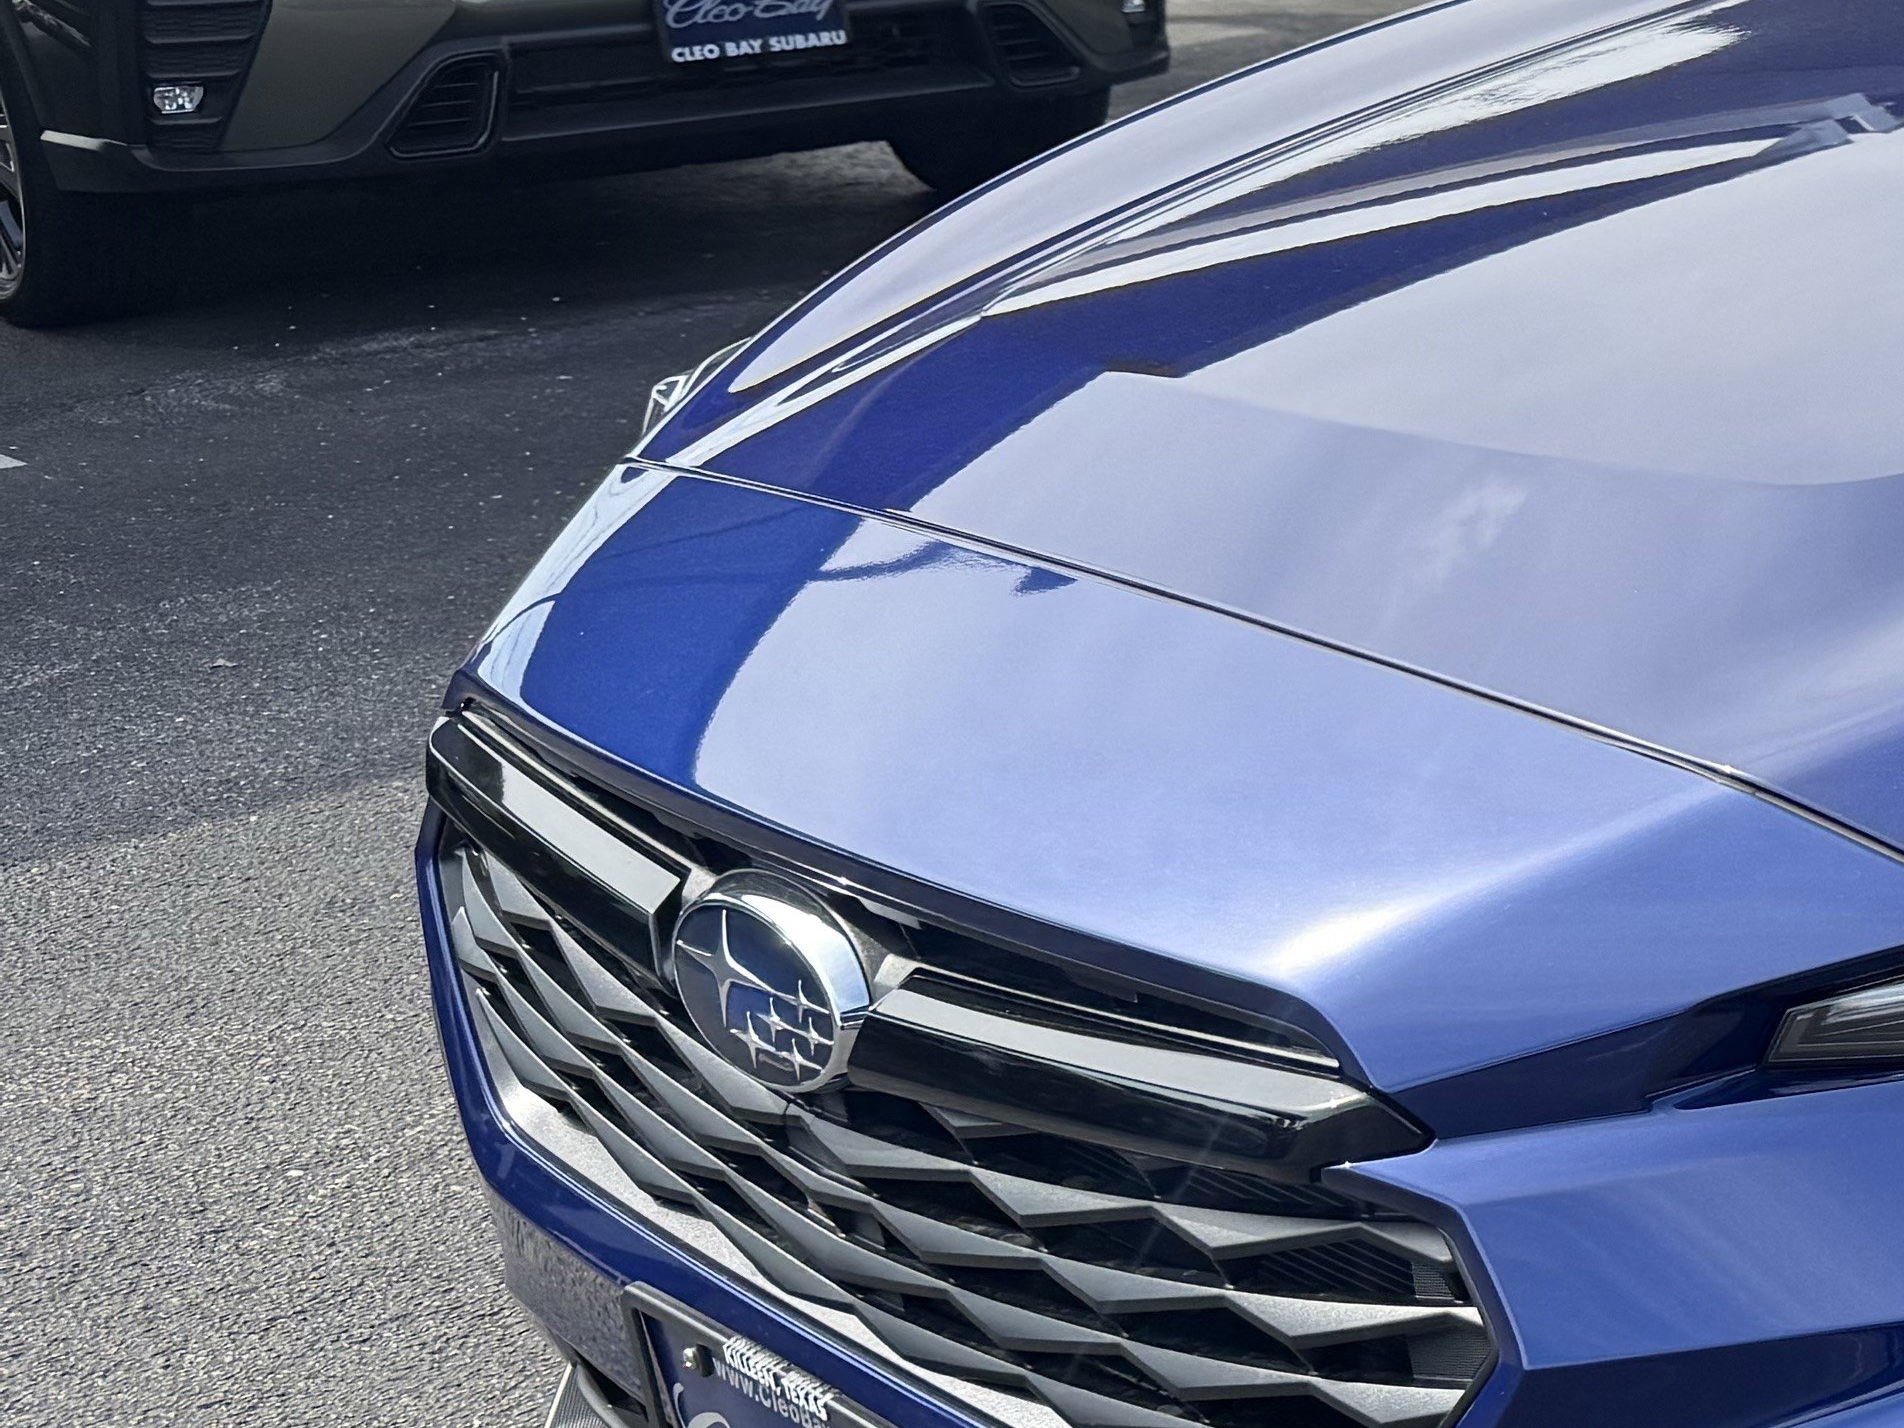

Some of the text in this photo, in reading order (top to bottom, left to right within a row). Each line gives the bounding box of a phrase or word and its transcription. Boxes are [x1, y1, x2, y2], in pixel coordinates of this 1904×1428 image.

[671, 29, 847, 63] CLEO BAY SUBARU
[781, 1375, 829, 1422] TEXAS
